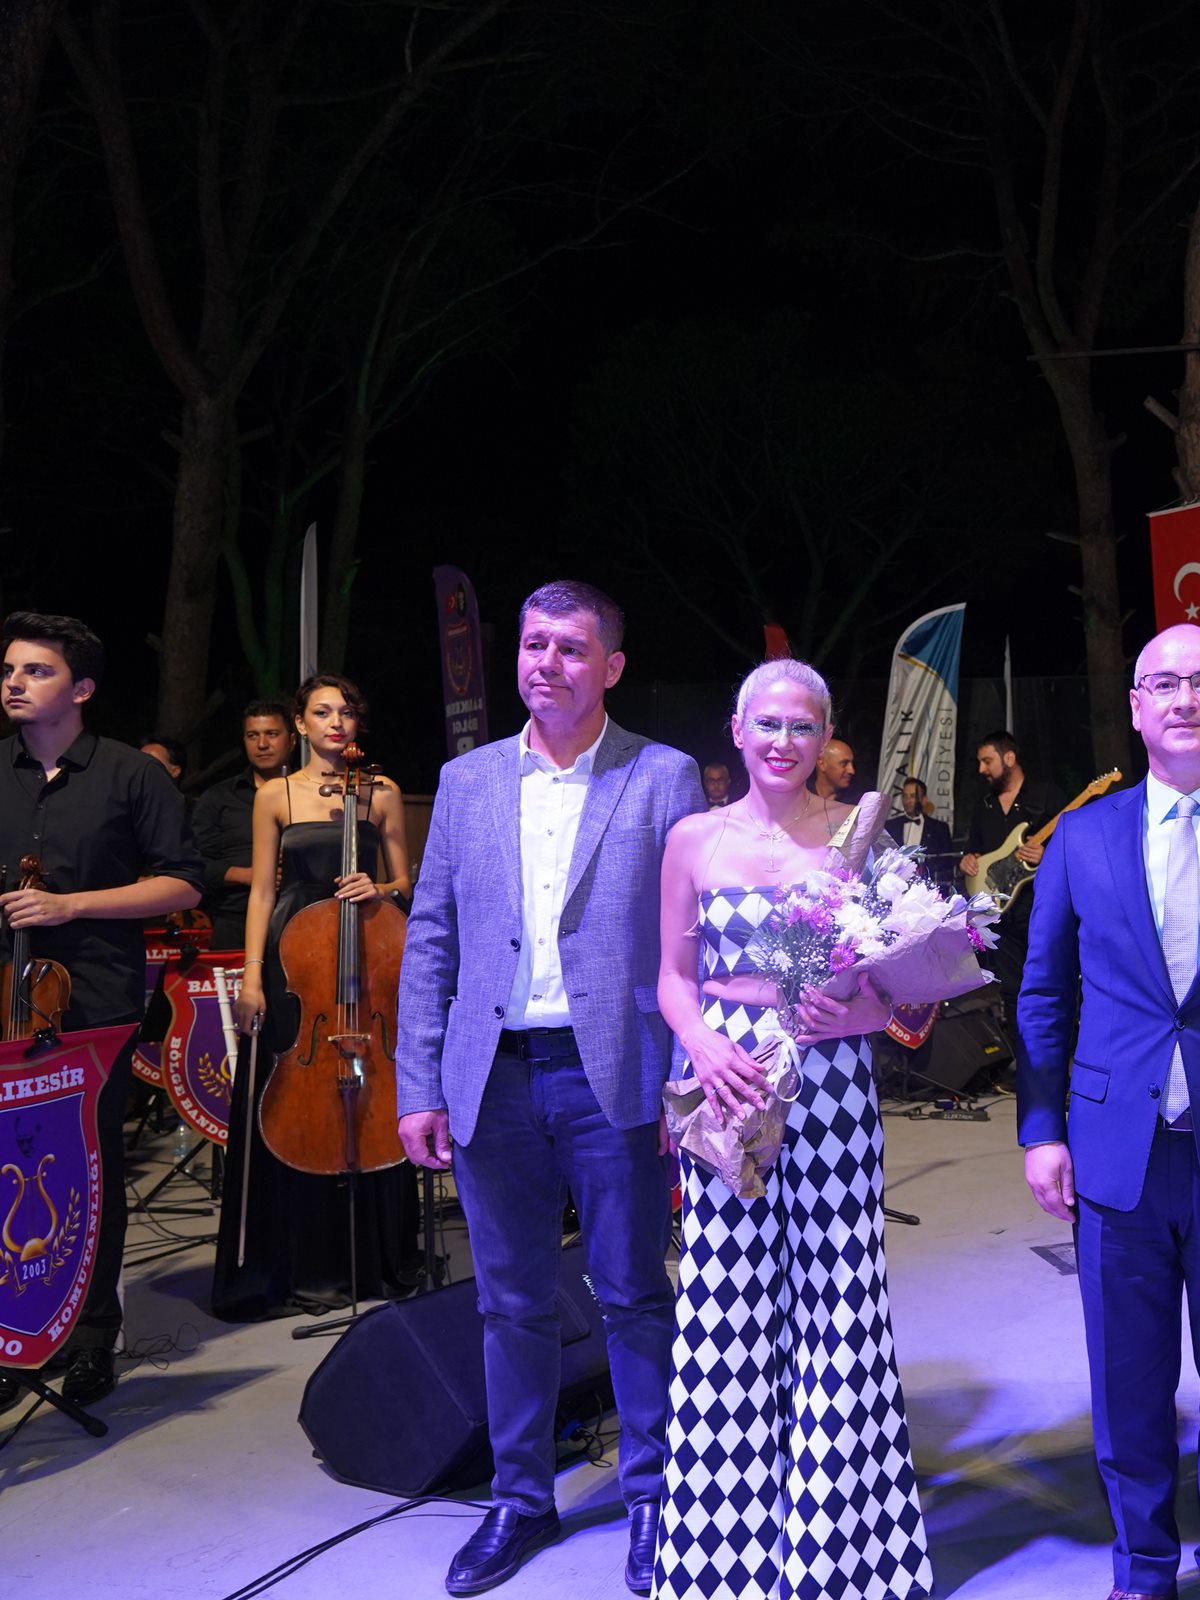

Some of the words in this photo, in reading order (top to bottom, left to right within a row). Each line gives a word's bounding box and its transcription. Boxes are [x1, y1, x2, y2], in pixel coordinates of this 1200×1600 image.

[891, 710, 914, 818] YVALIK
[0, 1065, 84, 1101] IKESİR
[180, 1099, 229, 1141] BANDO
[22, 1258, 46, 1280] 2003
